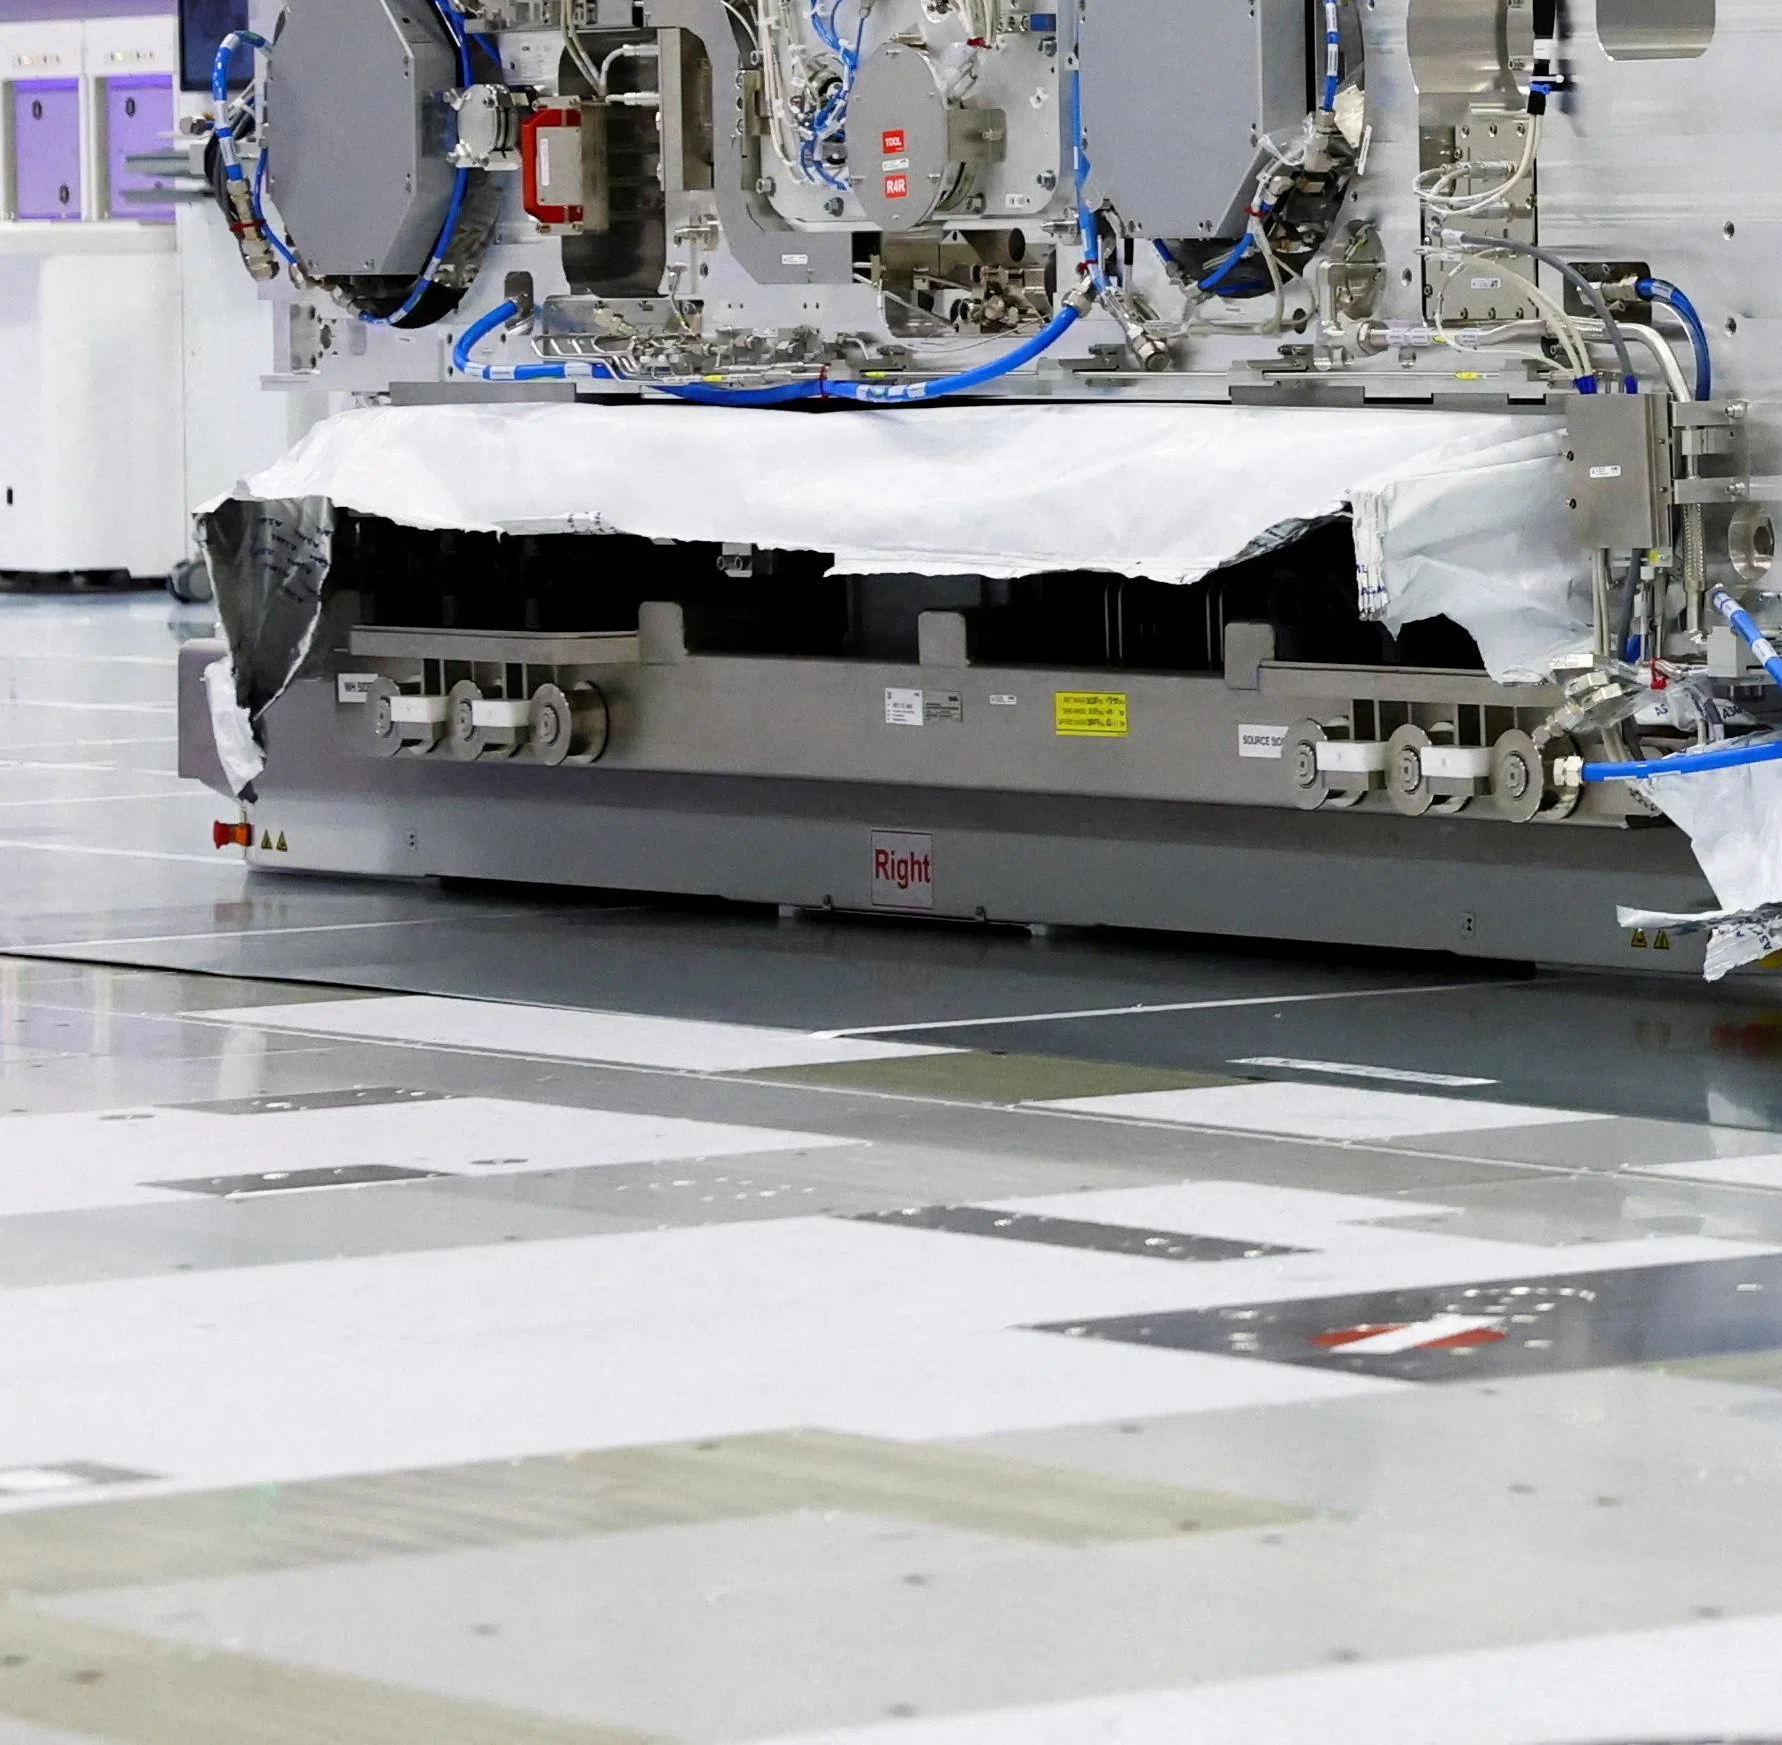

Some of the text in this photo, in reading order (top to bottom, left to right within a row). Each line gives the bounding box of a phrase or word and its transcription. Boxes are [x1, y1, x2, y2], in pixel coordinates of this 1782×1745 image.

[887, 179, 906, 194] R4R
[1242, 734, 1270, 747] SOURCE
[874, 849, 930, 890] Right
